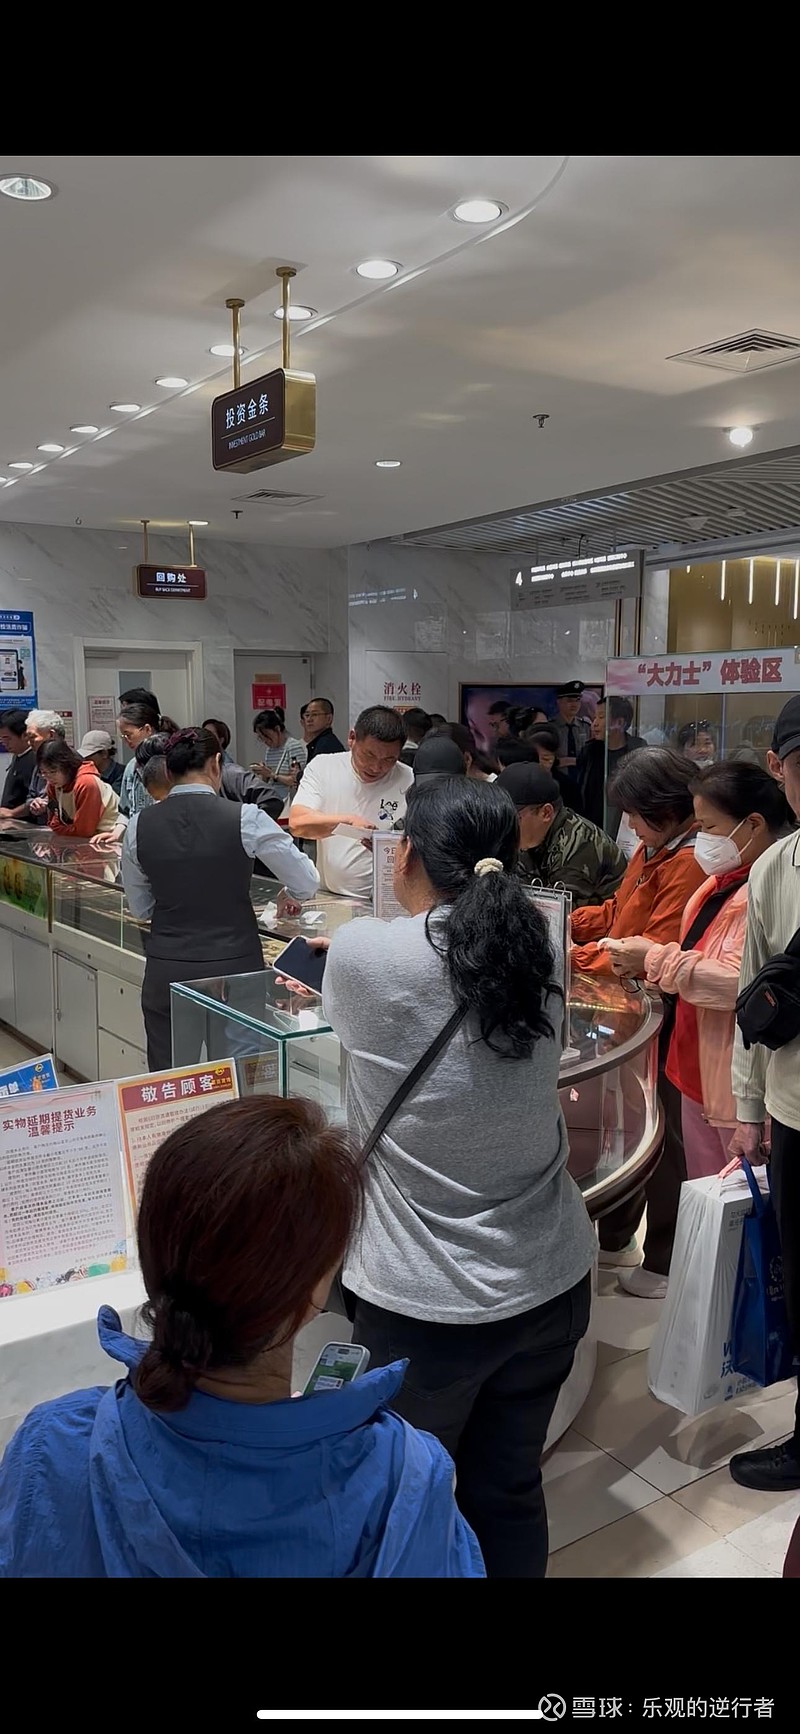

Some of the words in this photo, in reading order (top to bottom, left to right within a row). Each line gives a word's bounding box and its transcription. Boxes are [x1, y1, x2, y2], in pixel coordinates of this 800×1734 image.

[225, 393, 269, 429] 投资金条
[228, 435, 248, 450] INVESTMENT
[249, 432, 259, 442] GOLD
[156, 571, 187, 583] 回购处
[515, 571, 523, 586] 4
[383, 681, 422, 695] 消火栓
[141, 1074, 214, 1103] 敬告顾客
[2, 1105, 97, 1131] 实物延期提货业务
[28, 1122, 75, 1138] 温馨提示
